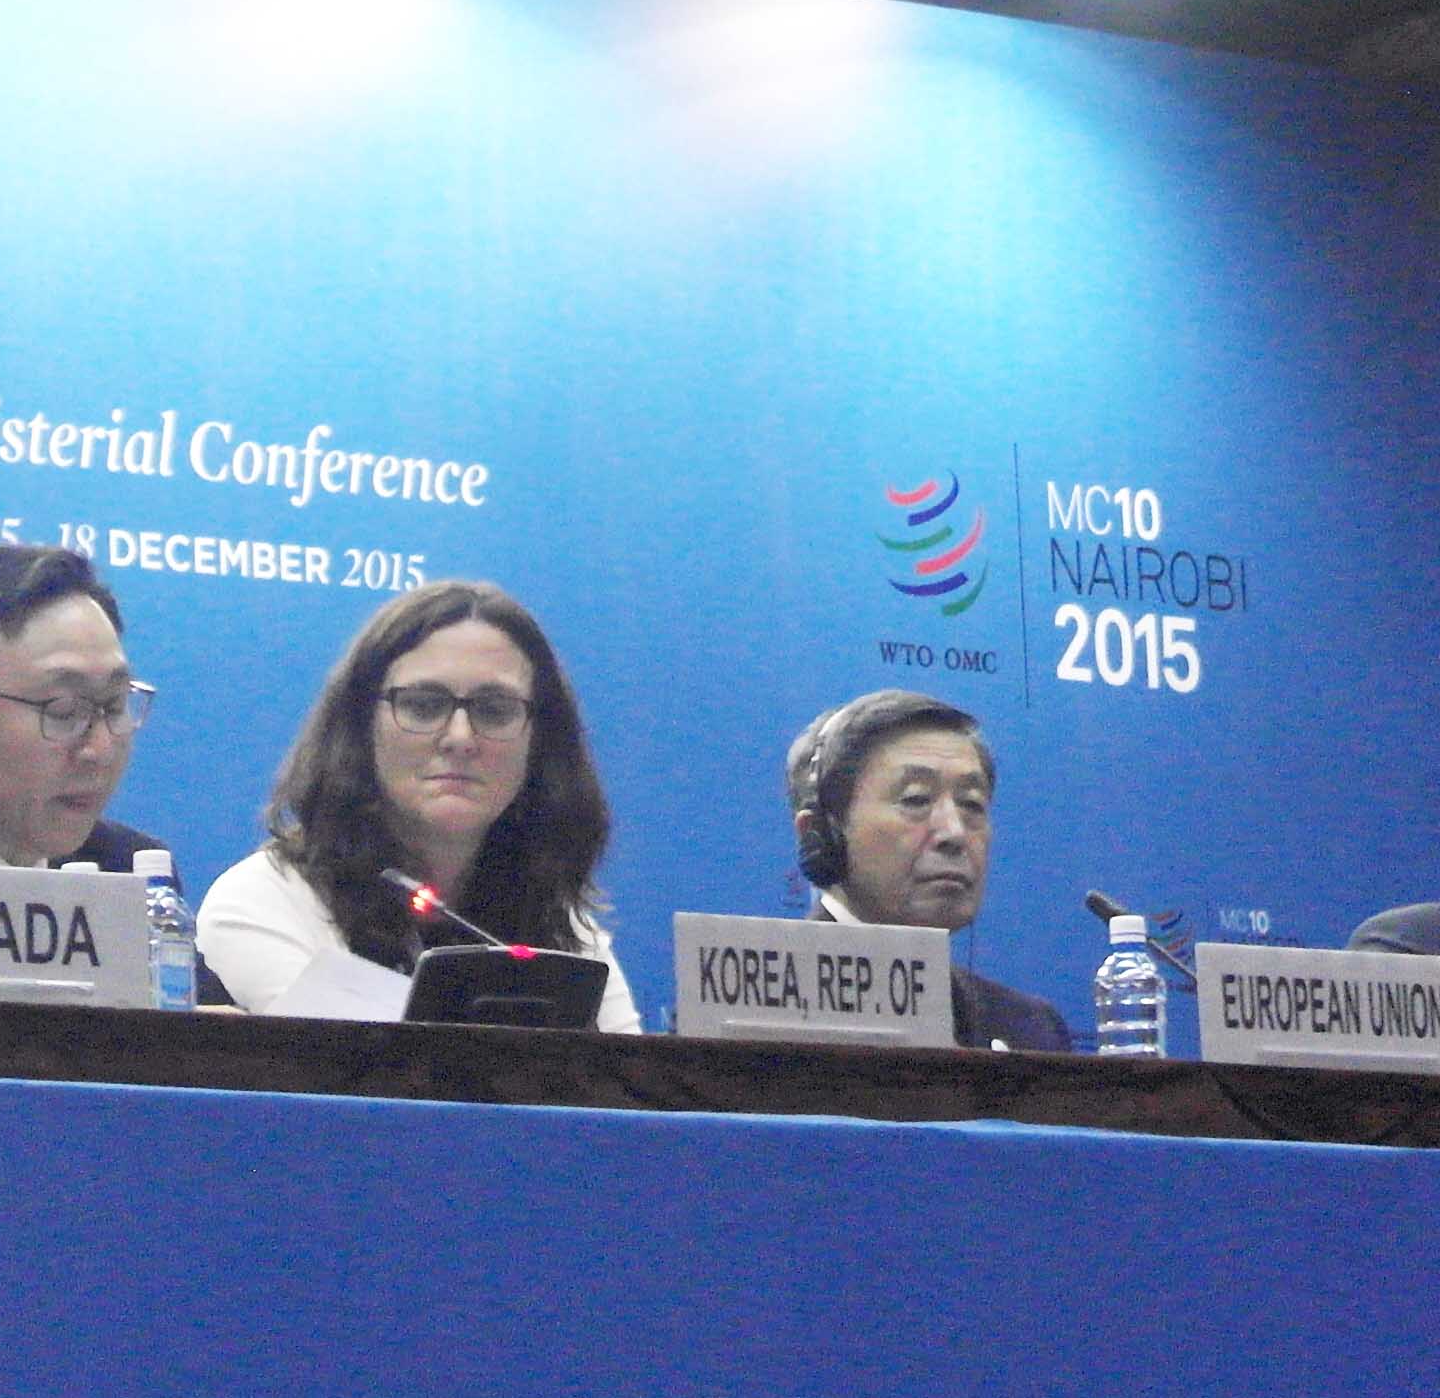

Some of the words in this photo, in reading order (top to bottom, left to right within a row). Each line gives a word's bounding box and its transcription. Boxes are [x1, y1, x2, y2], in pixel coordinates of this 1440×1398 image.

[189, 420, 490, 508] Conference
[1046, 480, 1162, 542] MC10
[59, 521, 98, 561] 18
[107, 528, 332, 586] DECEMBER
[340, 547, 426, 593] 2015
[1048, 536, 1250, 614] NAIROBI
[878, 640, 934, 668] WTO
[944, 647, 998, 675] OMC
[1053, 602, 1202, 695] 2015
[697, 944, 809, 1020] KOREA,
[816, 951, 882, 1016] REP.
[888, 958, 926, 1017] OF
[1221, 972, 1364, 1035] EUROPEAN
